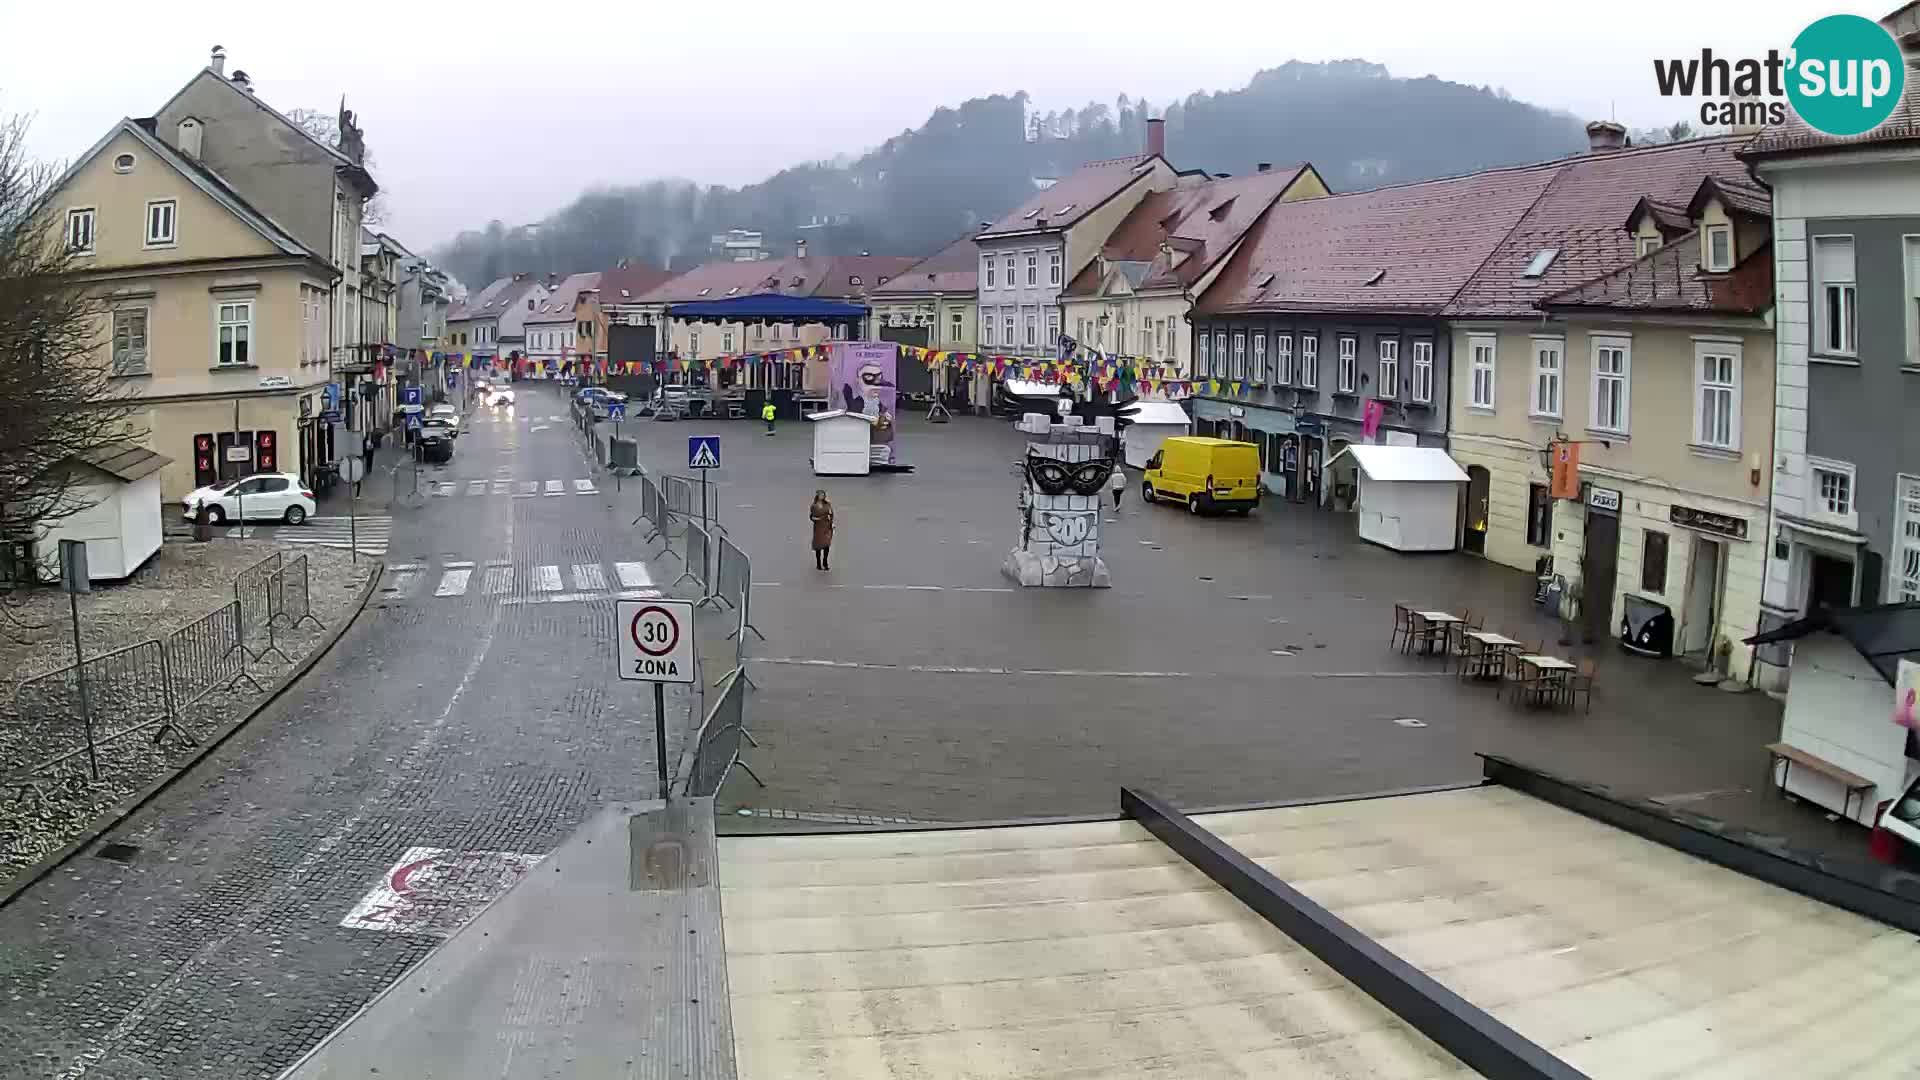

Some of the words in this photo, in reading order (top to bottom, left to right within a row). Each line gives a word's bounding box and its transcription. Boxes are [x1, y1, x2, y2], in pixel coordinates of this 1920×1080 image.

[408, 391, 416, 402] P
[1048, 516, 1087, 545] 200
[644, 622, 668, 643] 30
[634, 659, 679, 677] ZONA
